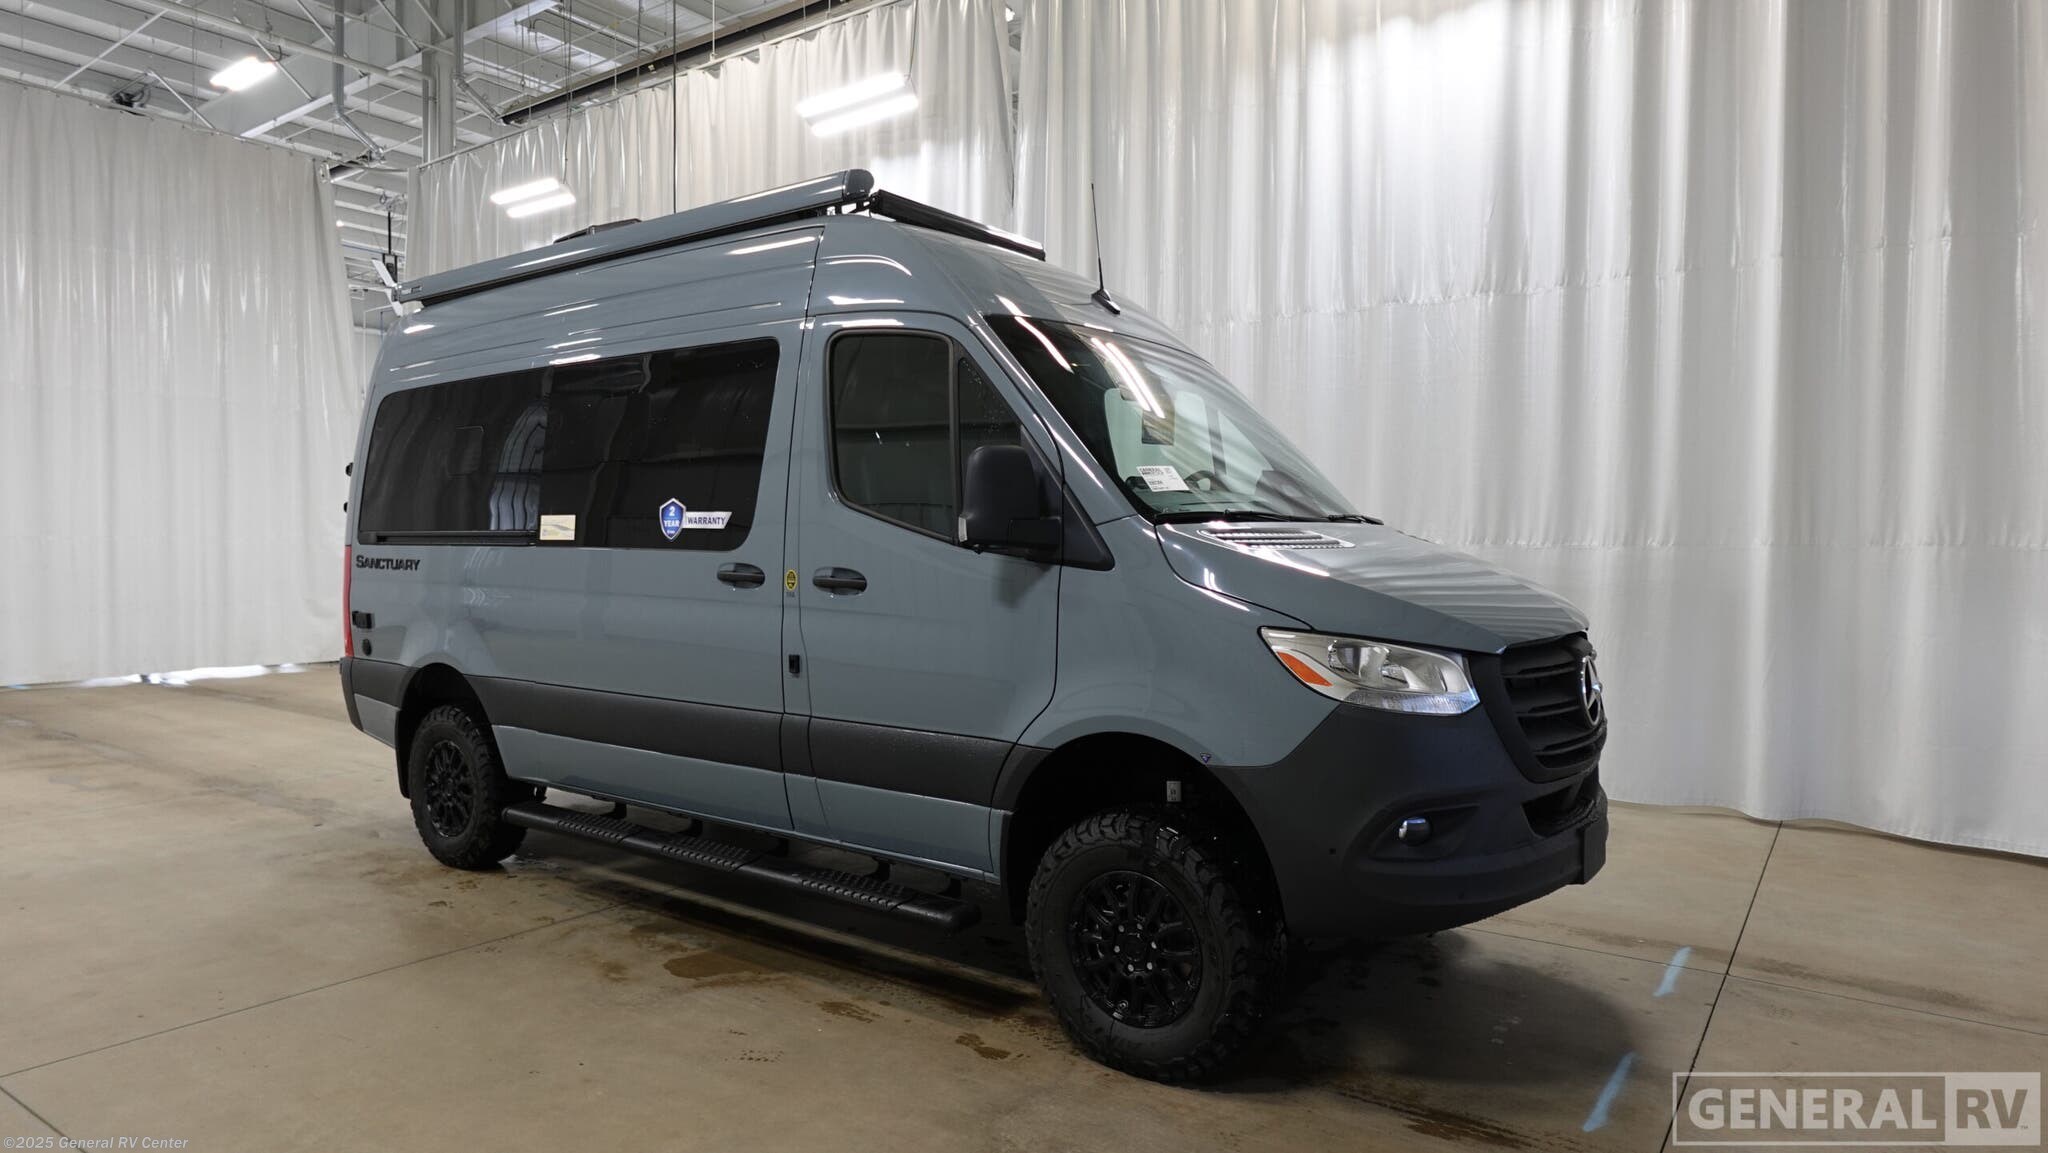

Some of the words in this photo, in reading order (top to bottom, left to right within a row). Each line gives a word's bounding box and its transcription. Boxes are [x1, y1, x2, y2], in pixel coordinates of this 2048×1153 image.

[668, 505, 676, 517] 2
[663, 519, 680, 528] YEAR
[687, 516, 726, 525] WARRANTY
[355, 554, 421, 571] SANCTUARY
